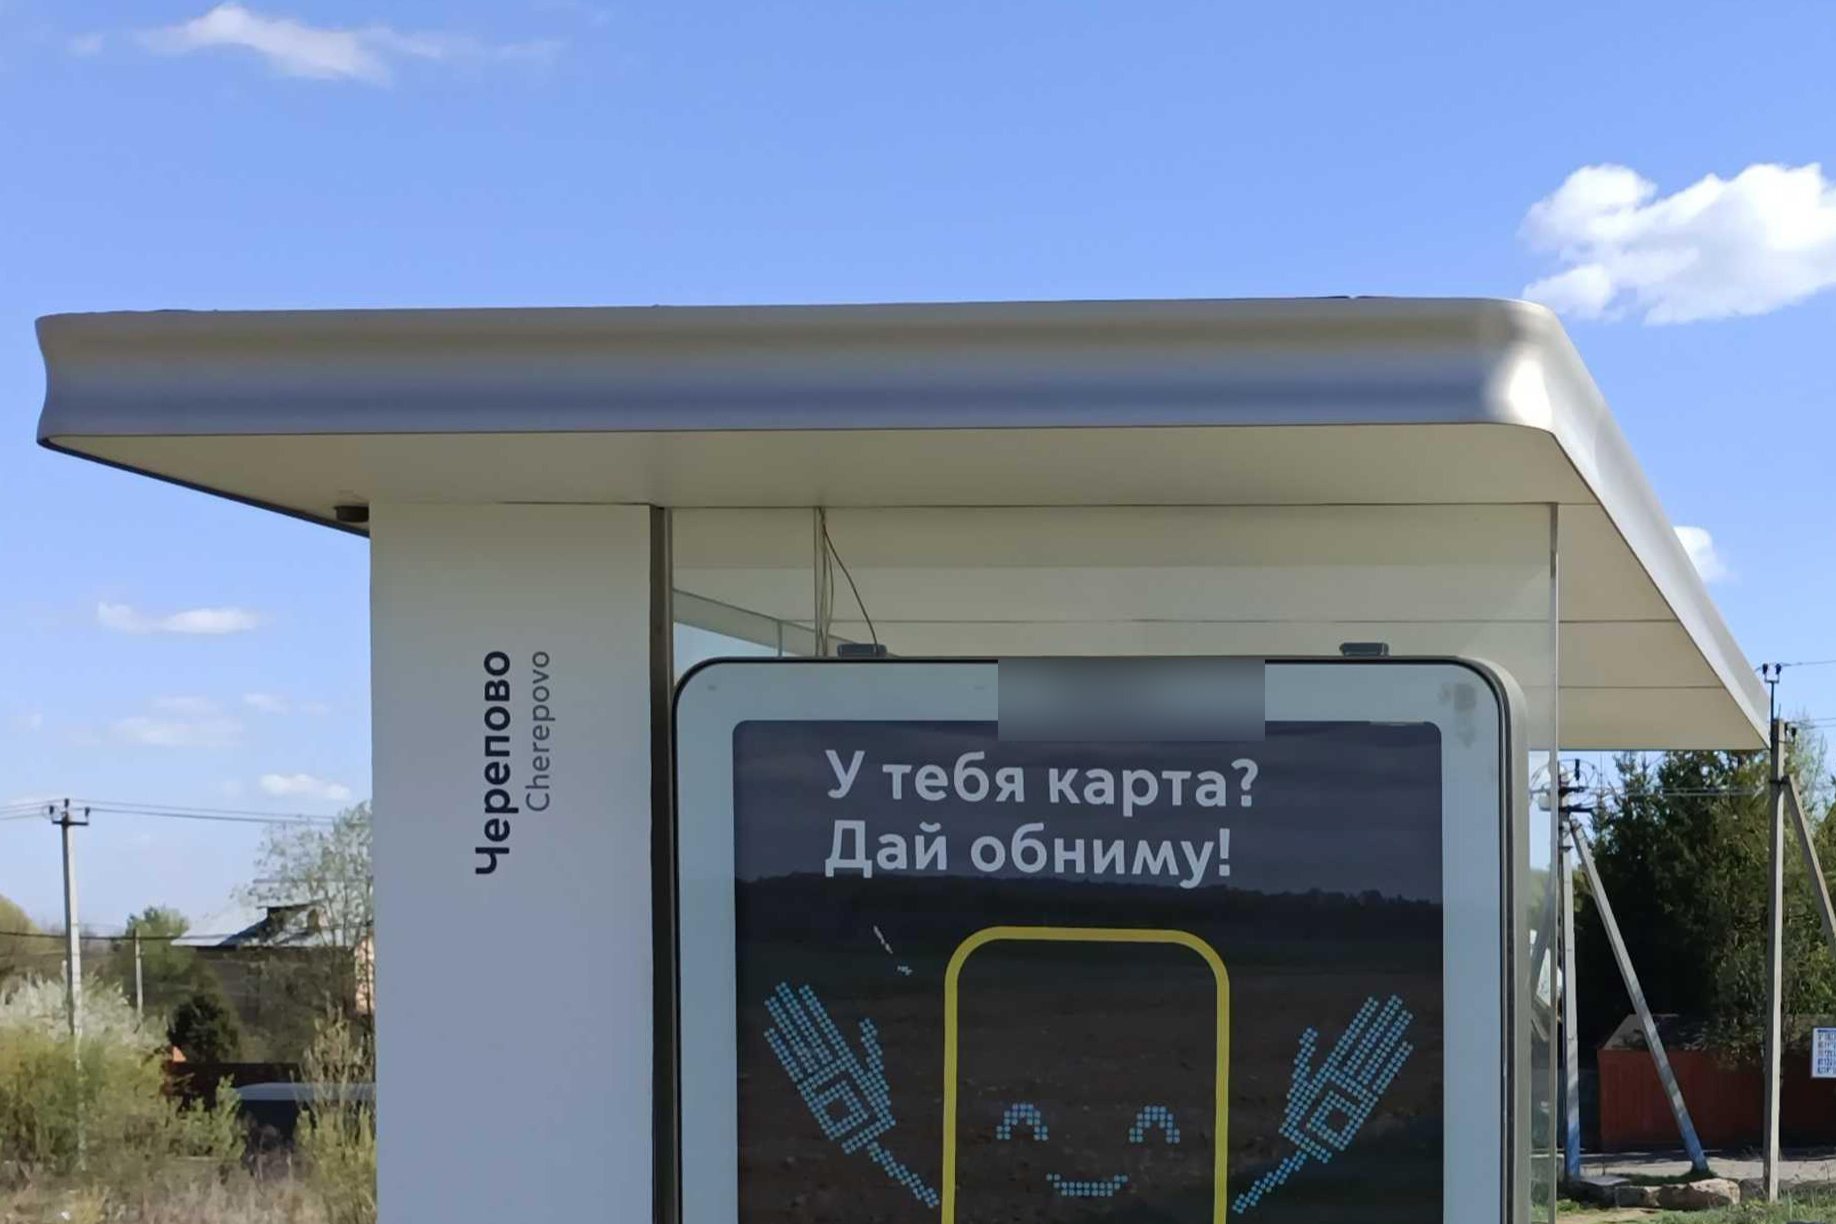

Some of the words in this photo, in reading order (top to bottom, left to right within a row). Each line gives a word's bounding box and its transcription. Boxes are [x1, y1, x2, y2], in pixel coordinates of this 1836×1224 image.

[475, 651, 519, 875] Черепово
[525, 651, 555, 812] Cherepovo
[825, 749, 865, 799] У
[883, 751, 1025, 803] тебя
[1049, 758, 1258, 818] карта?
[825, 819, 947, 879] Дай
[971, 823, 1231, 889] обниму!
